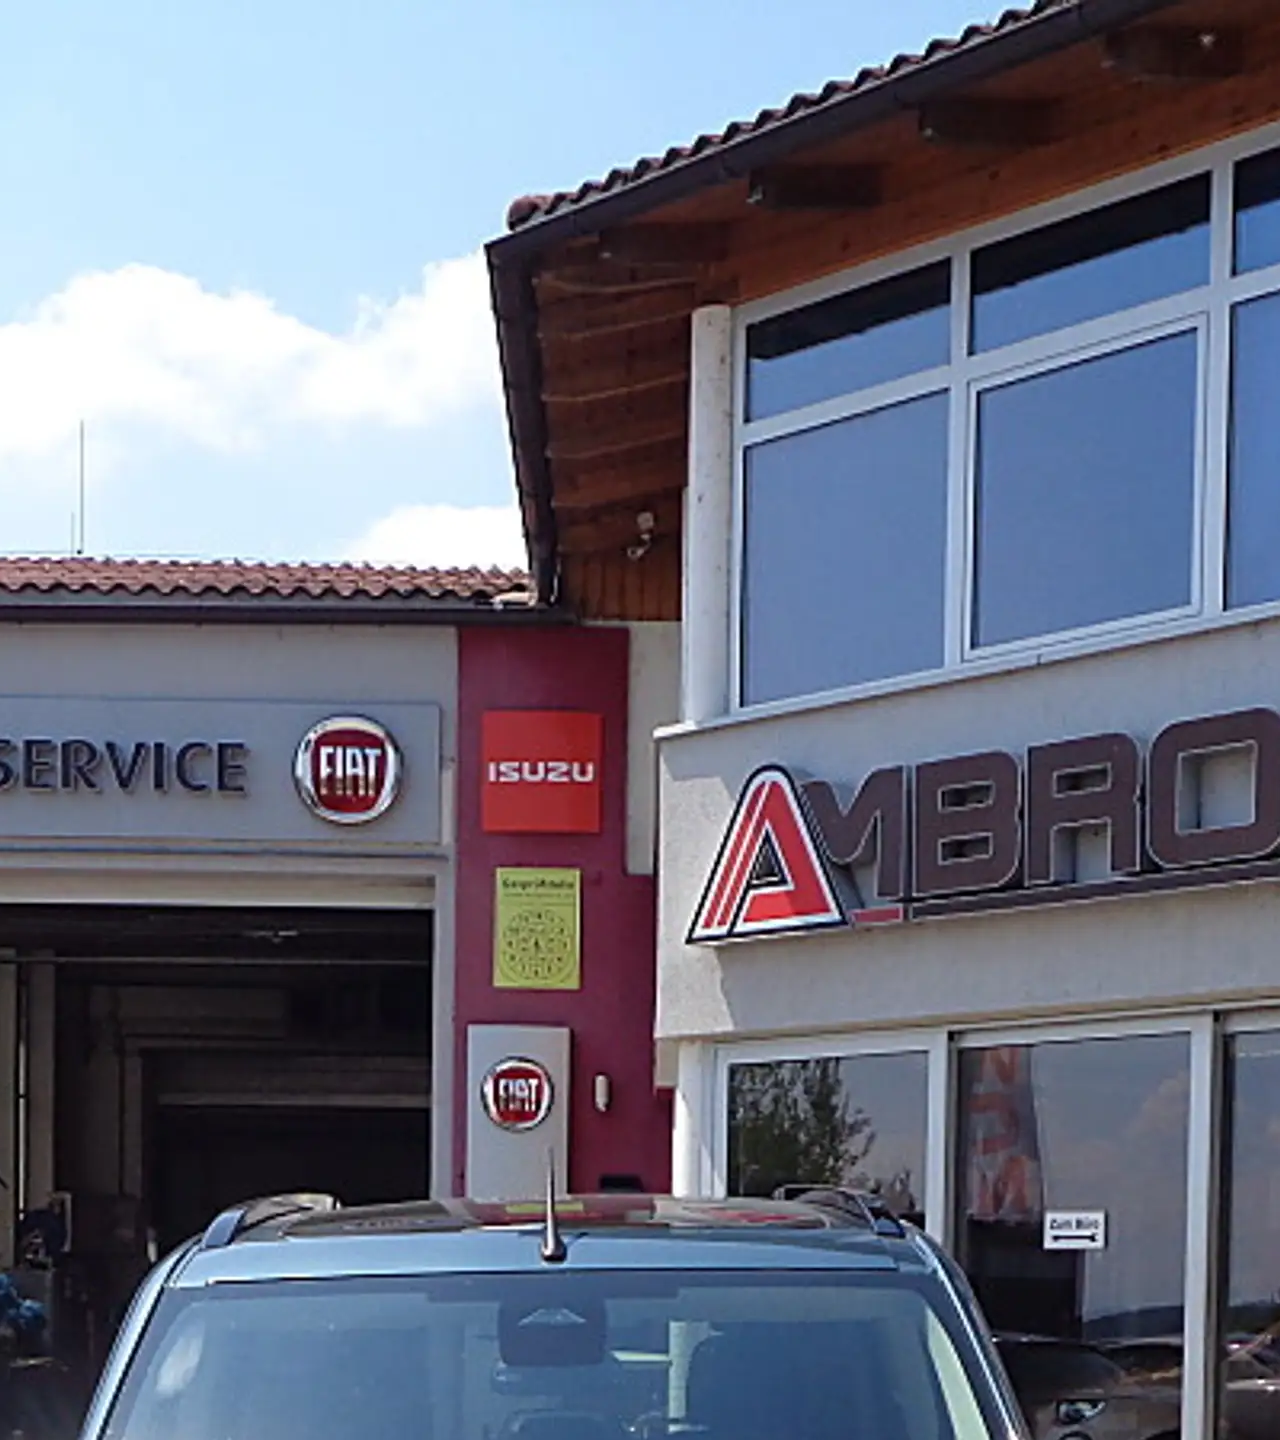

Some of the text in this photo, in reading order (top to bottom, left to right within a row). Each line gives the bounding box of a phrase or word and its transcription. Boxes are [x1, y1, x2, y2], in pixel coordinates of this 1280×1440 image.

[319, 745, 382, 797] FIAT
[488, 761, 595, 783] ISUZU
[498, 1078, 540, 1112] FIAT
